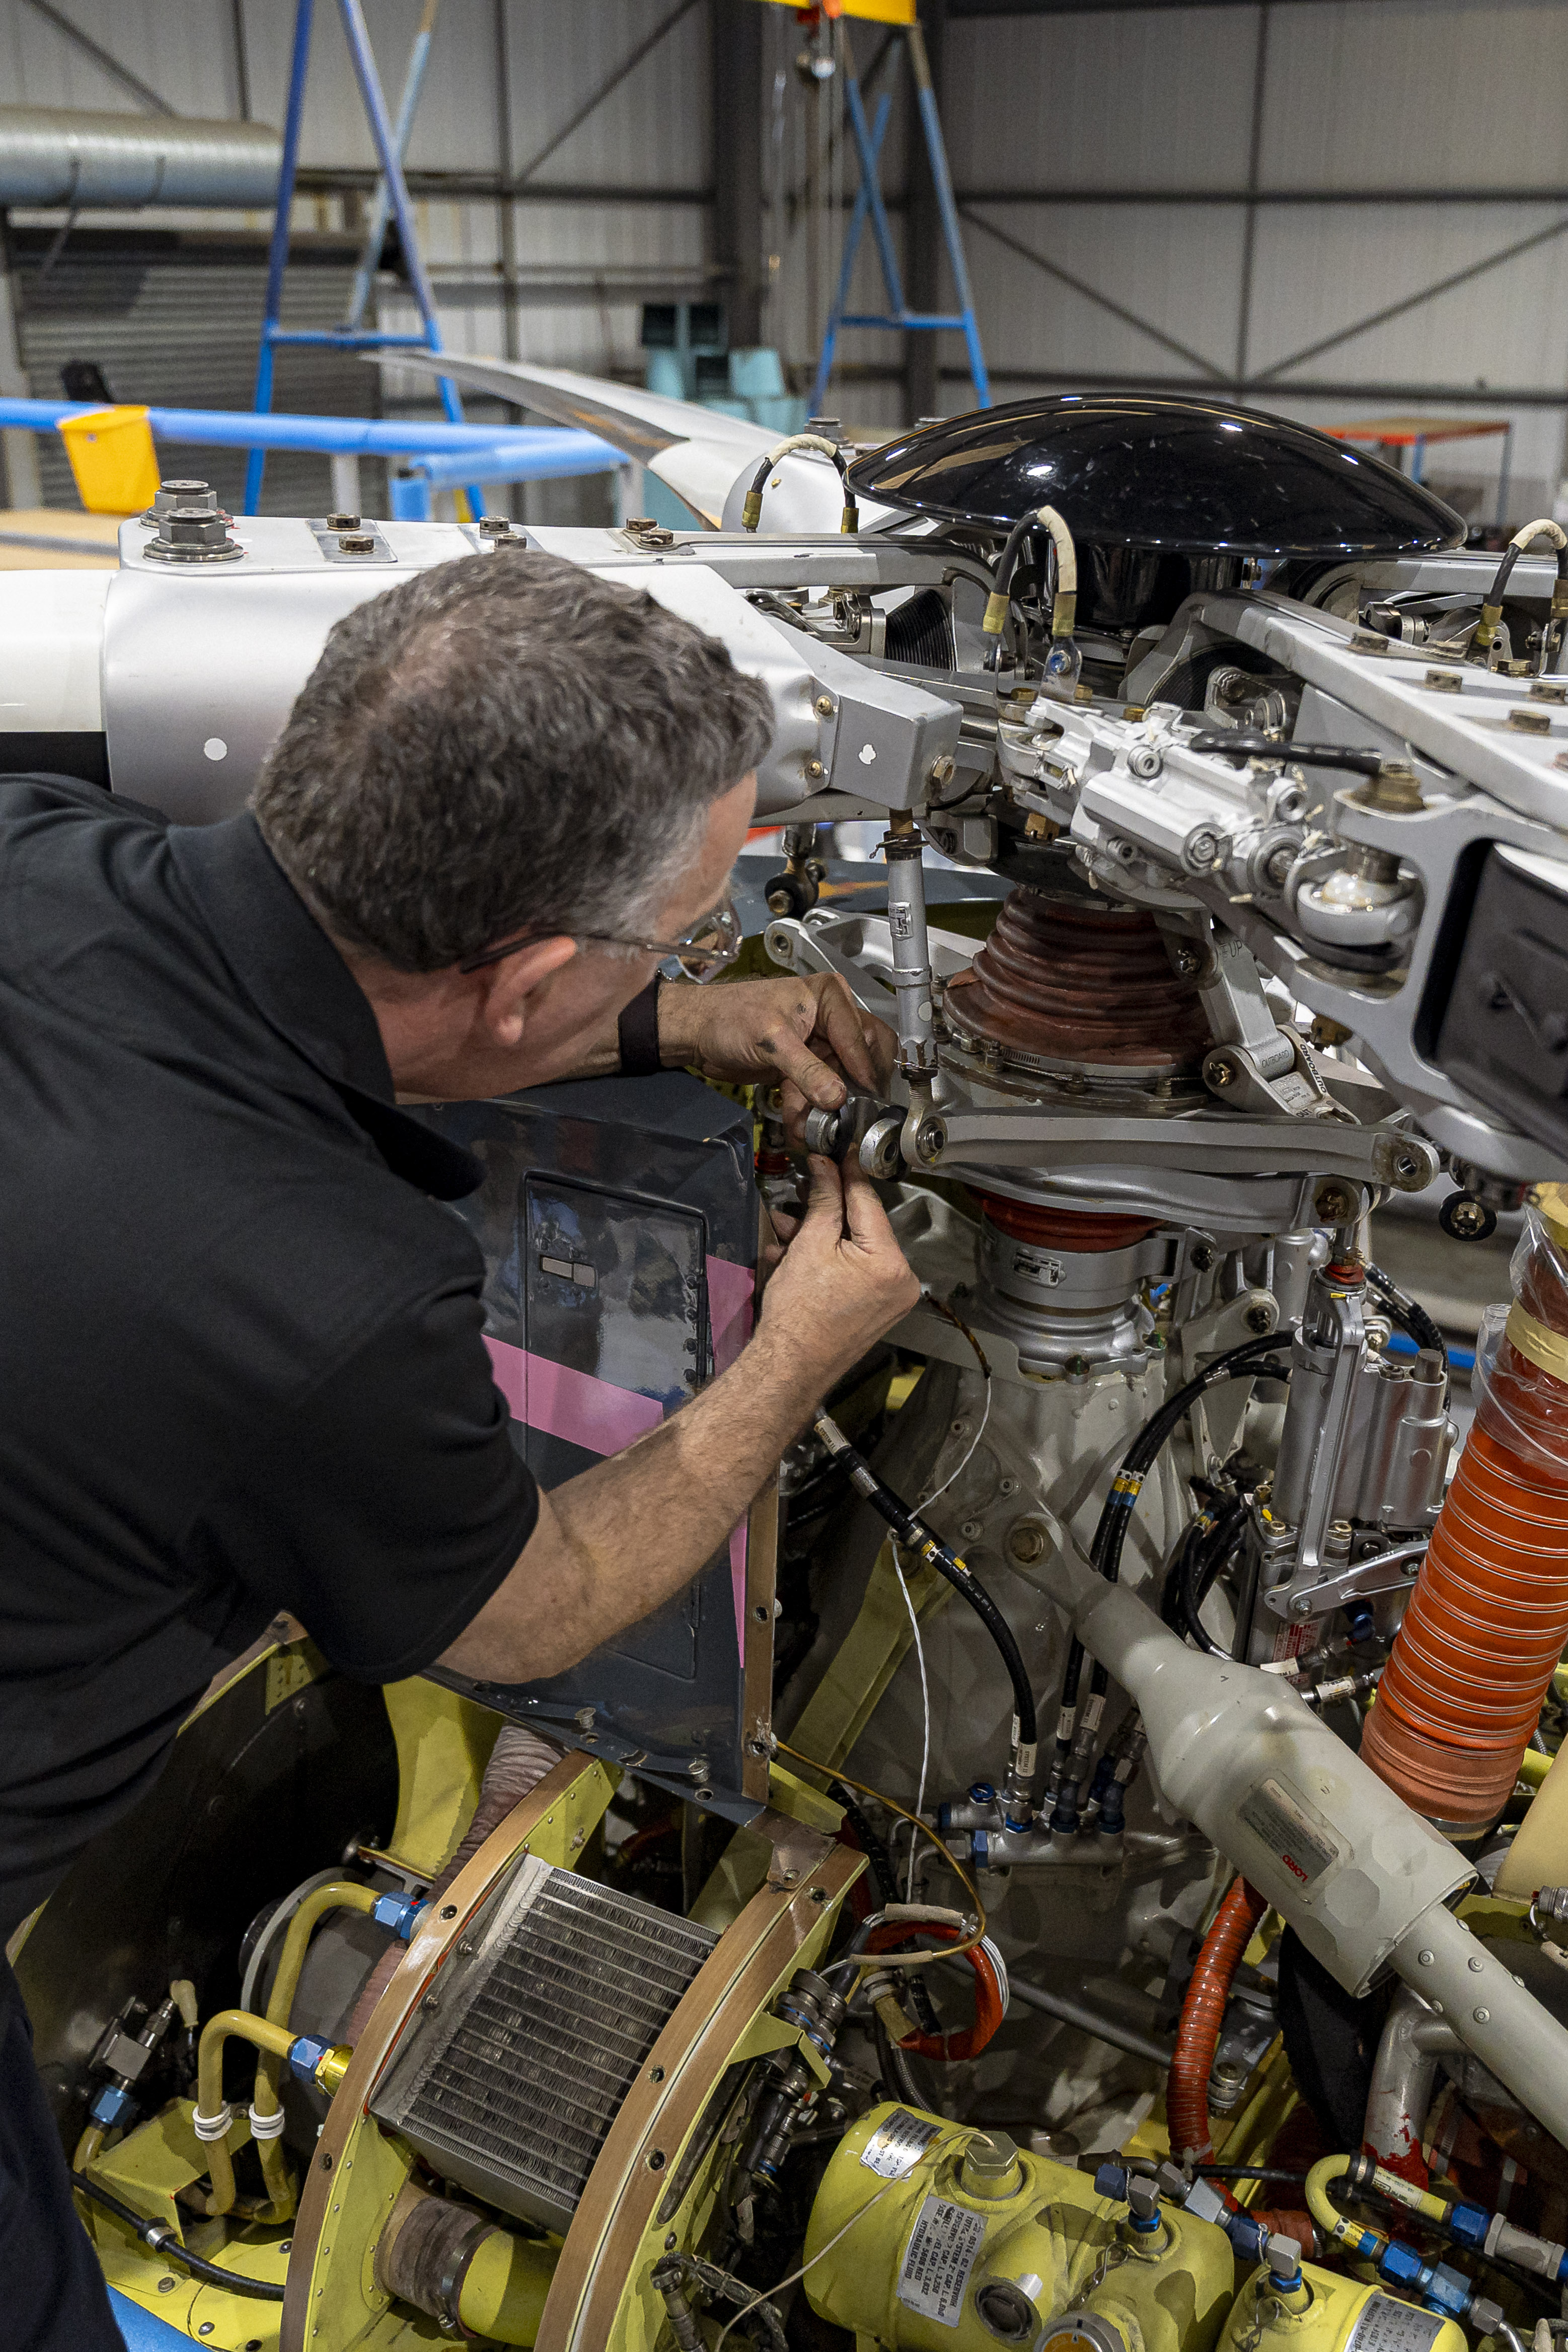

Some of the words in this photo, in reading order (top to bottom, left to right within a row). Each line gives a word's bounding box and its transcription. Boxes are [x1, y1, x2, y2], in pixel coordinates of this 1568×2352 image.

[1261, 1050, 1289, 1068] OUTBOARD
[1300, 1044, 1326, 1093] OUTBOARD
[1296, 1109, 1312, 1118] OUT
[1282, 1855, 1308, 1883] LORD
[959, 2215, 974, 2236] TOTAL
[910, 2220, 929, 2259] HYDRAULIC
[950, 2236, 966, 2264] SYSTEM
[904, 2259, 918, 2280] FLUID
[914, 2266, 925, 2281] RED
[949, 2269, 965, 2308] RESERVOIR
